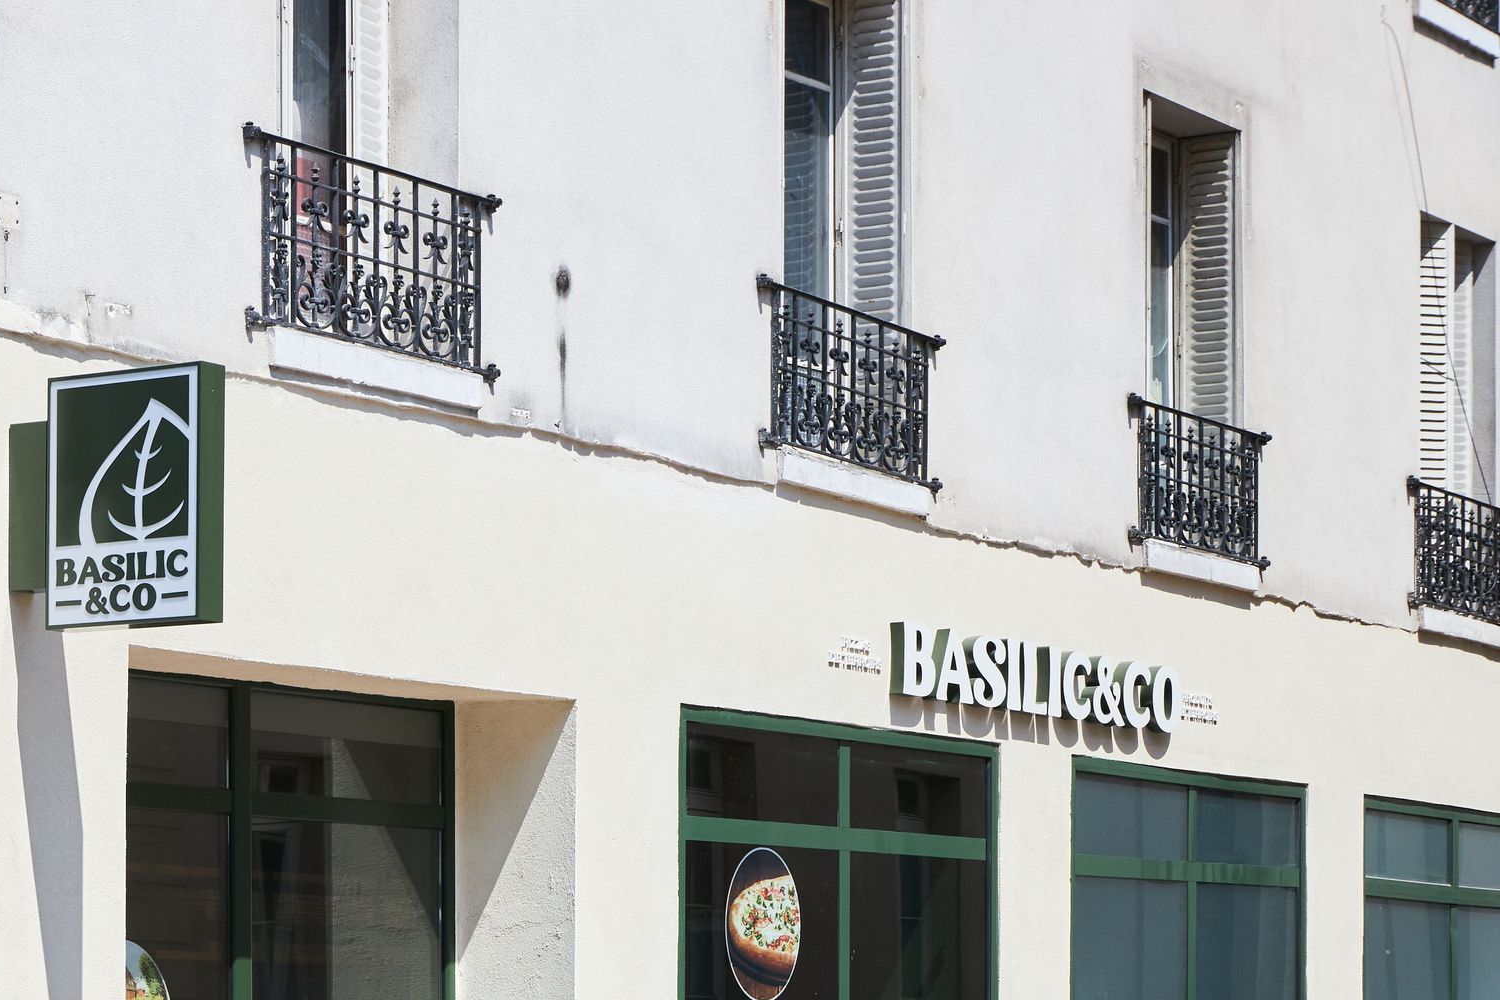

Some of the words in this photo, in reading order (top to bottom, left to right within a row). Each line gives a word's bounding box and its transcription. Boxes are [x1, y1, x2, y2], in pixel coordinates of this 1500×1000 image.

[55, 549, 189, 587] BASILIC
[85, 583, 157, 615] &CO
[891, 620, 1180, 734] BASILIC&CO
